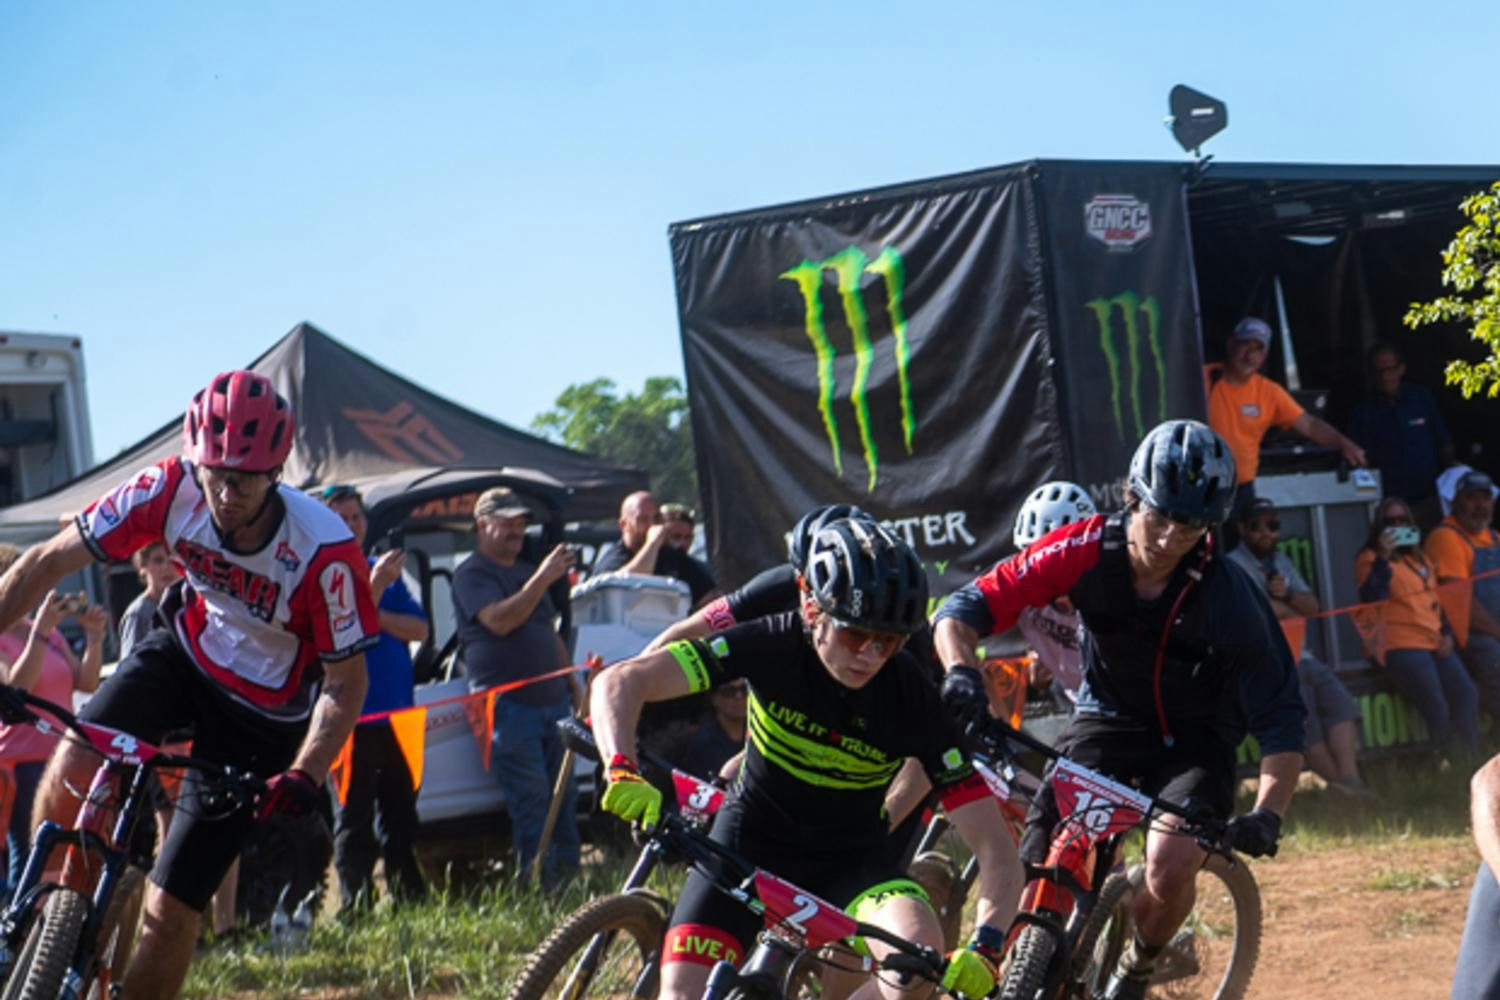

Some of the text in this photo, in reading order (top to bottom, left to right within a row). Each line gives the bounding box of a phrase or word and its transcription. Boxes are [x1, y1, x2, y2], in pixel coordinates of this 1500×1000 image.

[1089, 207, 1148, 229] GNCC
[768, 702, 807, 732] LIVE
[111, 732, 139, 753] 4
[688, 784, 716, 810] 3
[784, 894, 819, 935] 2
[671, 935, 723, 960] LIVE
